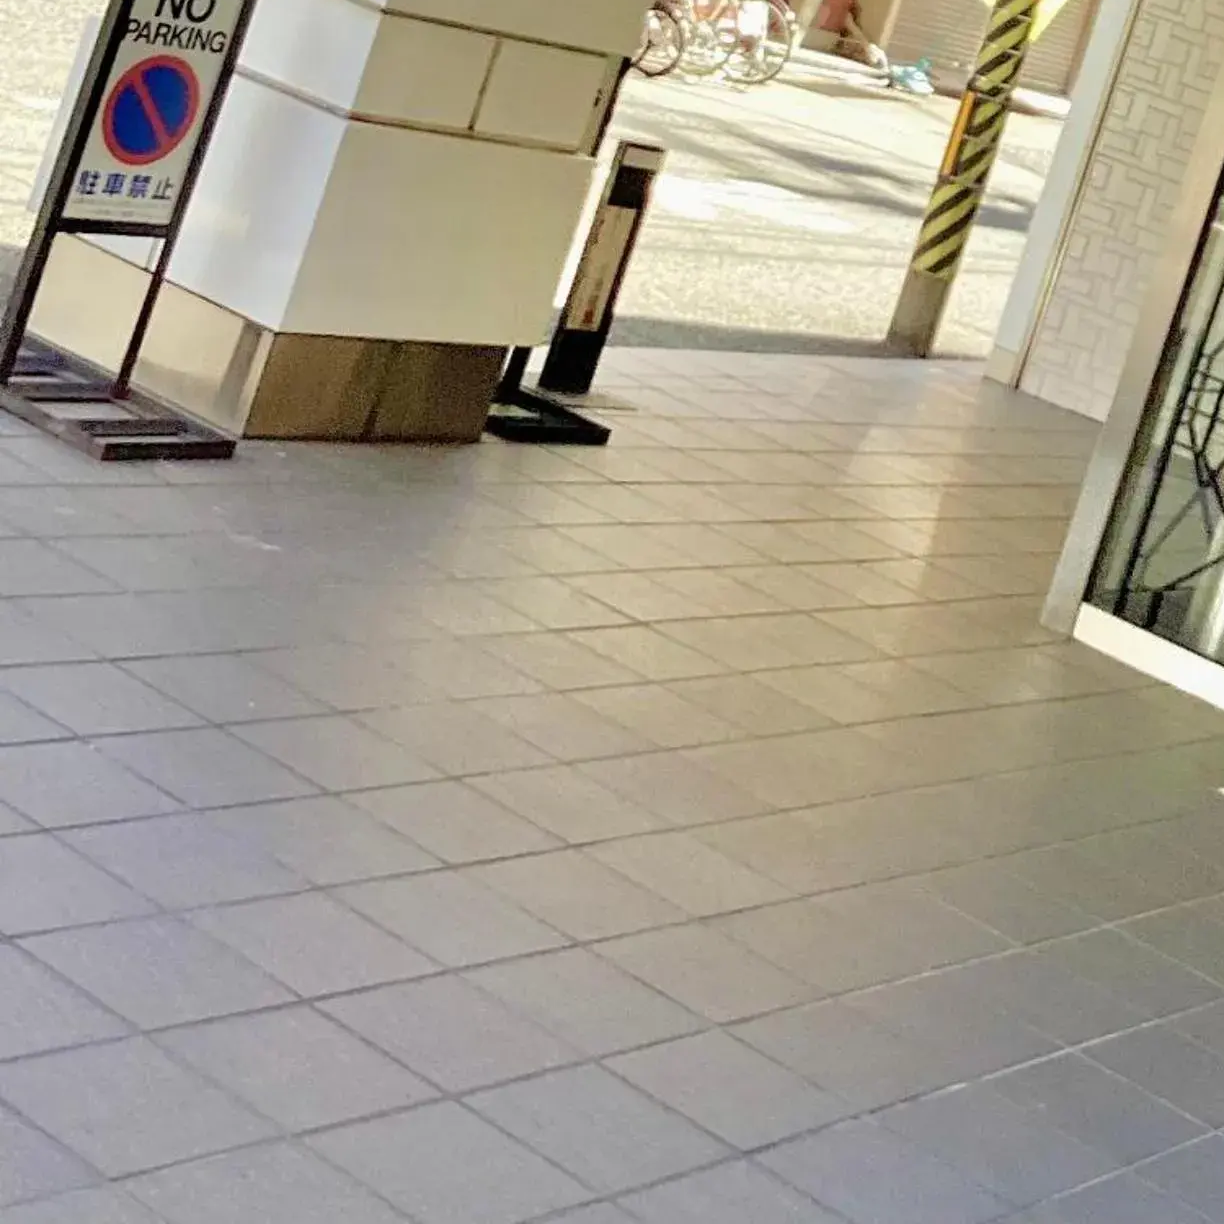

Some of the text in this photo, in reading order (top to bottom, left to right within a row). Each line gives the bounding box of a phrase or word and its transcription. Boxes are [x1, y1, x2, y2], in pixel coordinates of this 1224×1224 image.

[123, 18, 228, 53] PARKING
[77, 171, 174, 200] 駐車禁止
